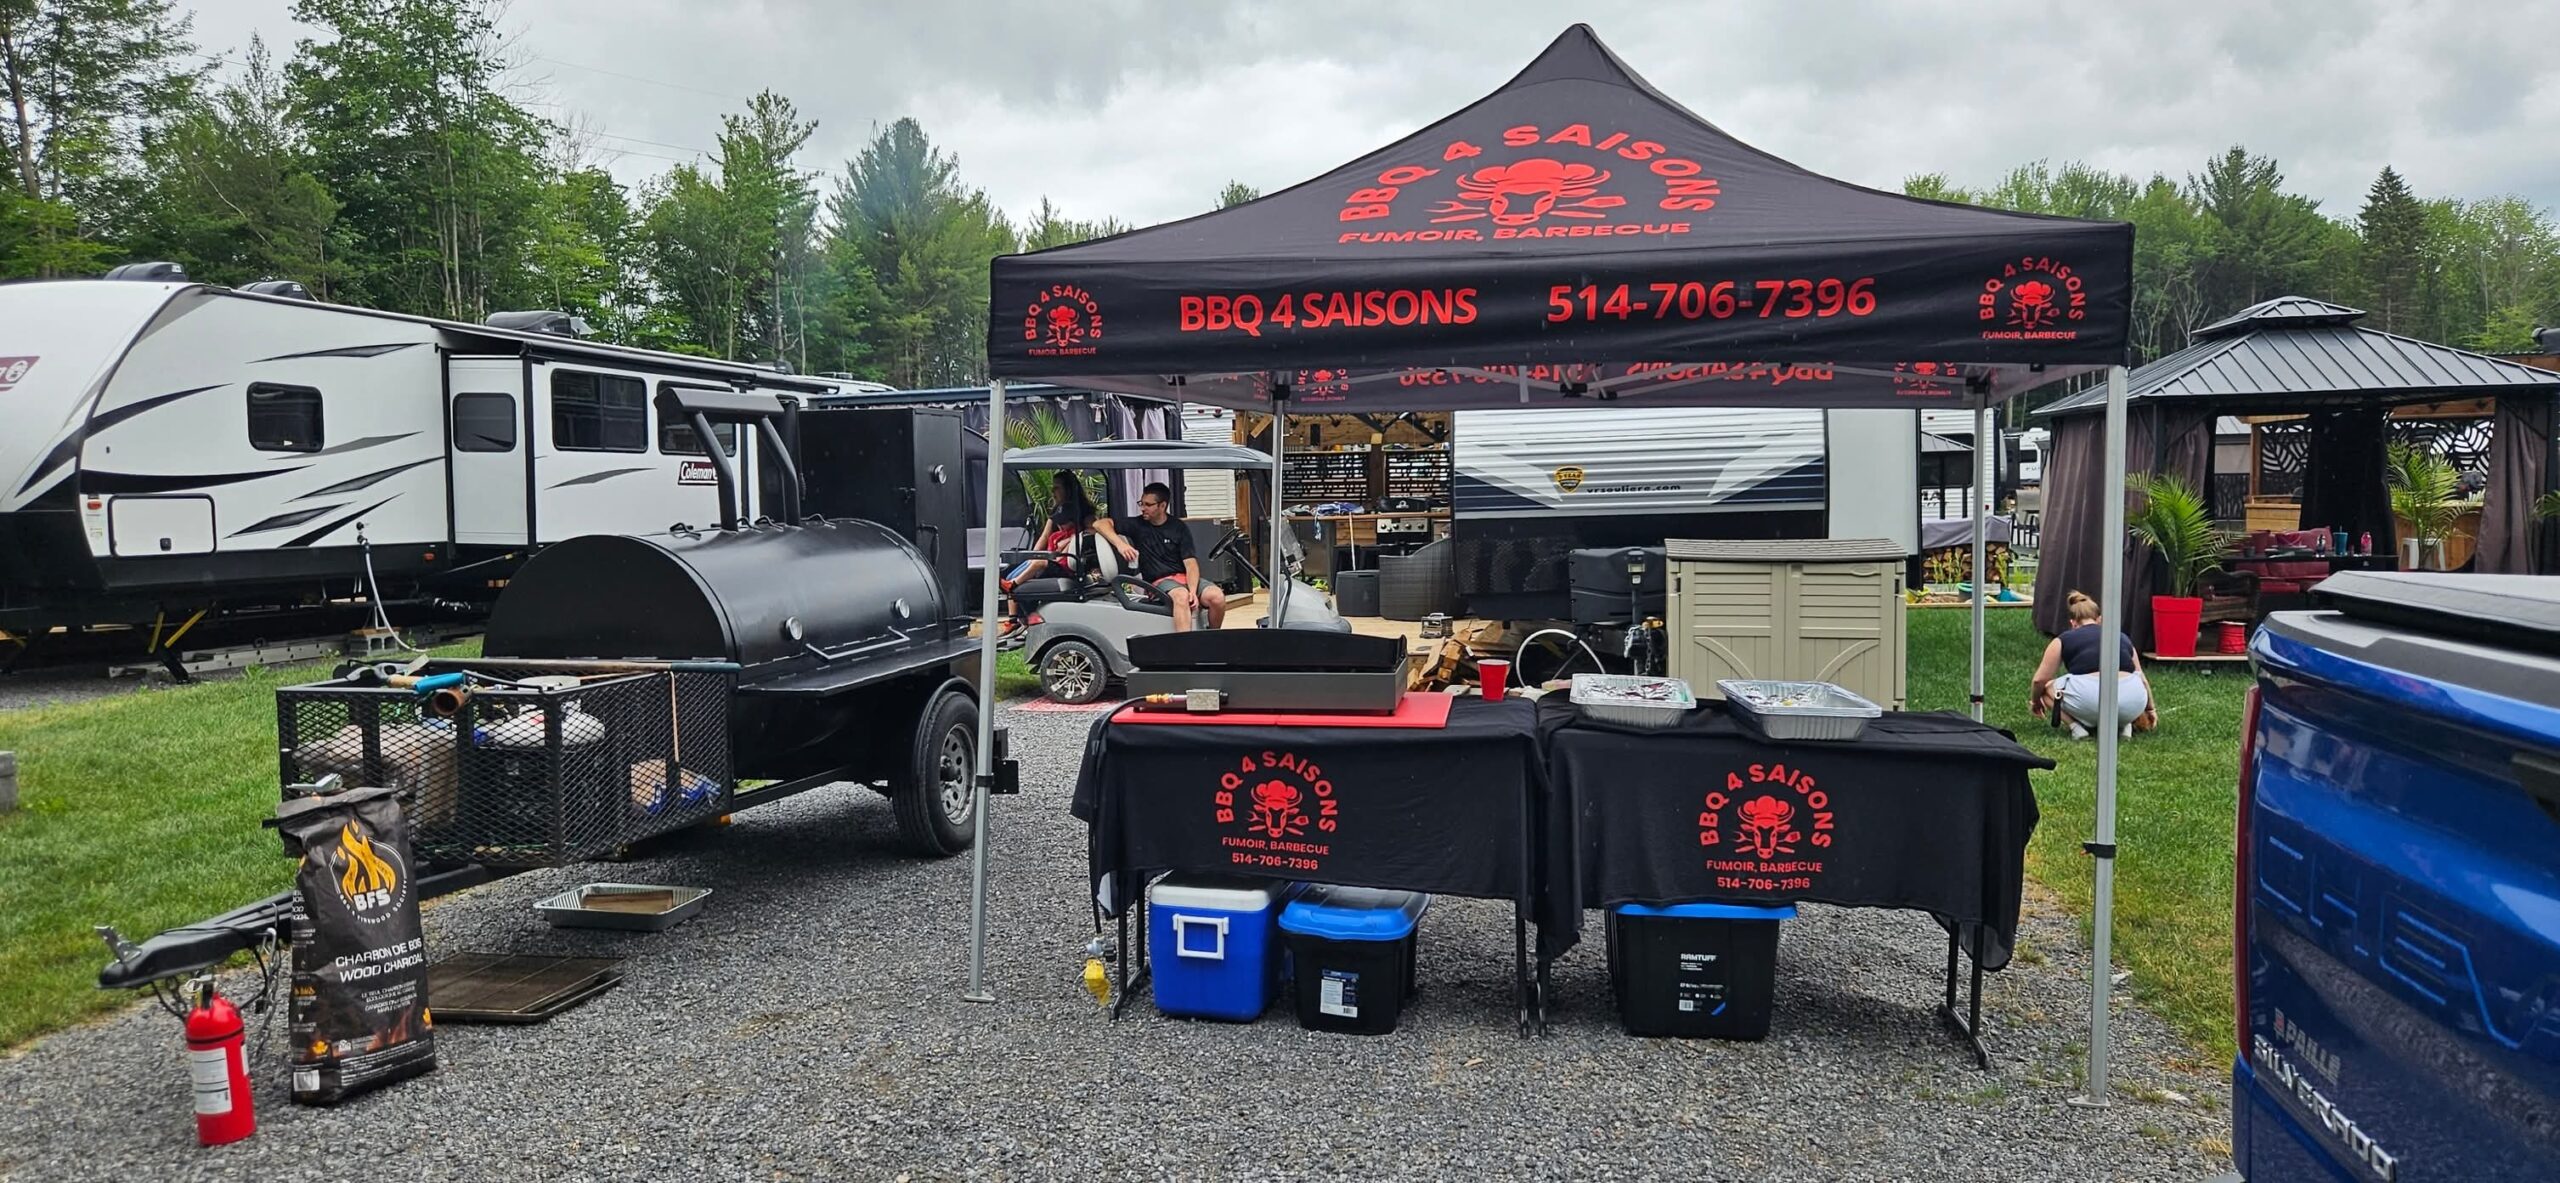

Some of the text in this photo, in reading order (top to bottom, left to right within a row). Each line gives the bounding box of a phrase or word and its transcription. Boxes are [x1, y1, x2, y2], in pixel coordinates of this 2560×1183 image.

[1340, 123, 1721, 221] BBQ 4 SAISONS
[1339, 221, 1690, 244] FUMOIR, BARBECUE
[1548, 277, 1876, 322] 514-706-7396
[1980, 257, 2085, 319] BBQ 4 SAISONS
[1025, 285, 1102, 340] BBQ 4 SAISONS
[1180, 288, 1478, 337] BBQ 4 SAISONS
[681, 463, 712, 480] Coleman
[1587, 484, 1681, 493] vrsouliere.com
[1215, 752, 1337, 834] BBQ 4 SAISONS
[1698, 763, 1833, 850] BBQ 4 SAISONS
[1222, 837, 1330, 855] FUMOIR, BARBECUE
[1231, 852, 1318, 870] 514-706-7396
[1706, 860, 1823, 873] FUMOIR, BARBECUE
[1716, 876, 1810, 890] 514-706-7396
[353, 888, 391, 911] BFS
[335, 937, 422, 968] CHARBON DE BOS
[339, 952, 424, 983] WOOD CHARCOAL
[1680, 953, 1717, 961] RAMTUFF
[2254, 1033, 2398, 1183] SILVERADO
